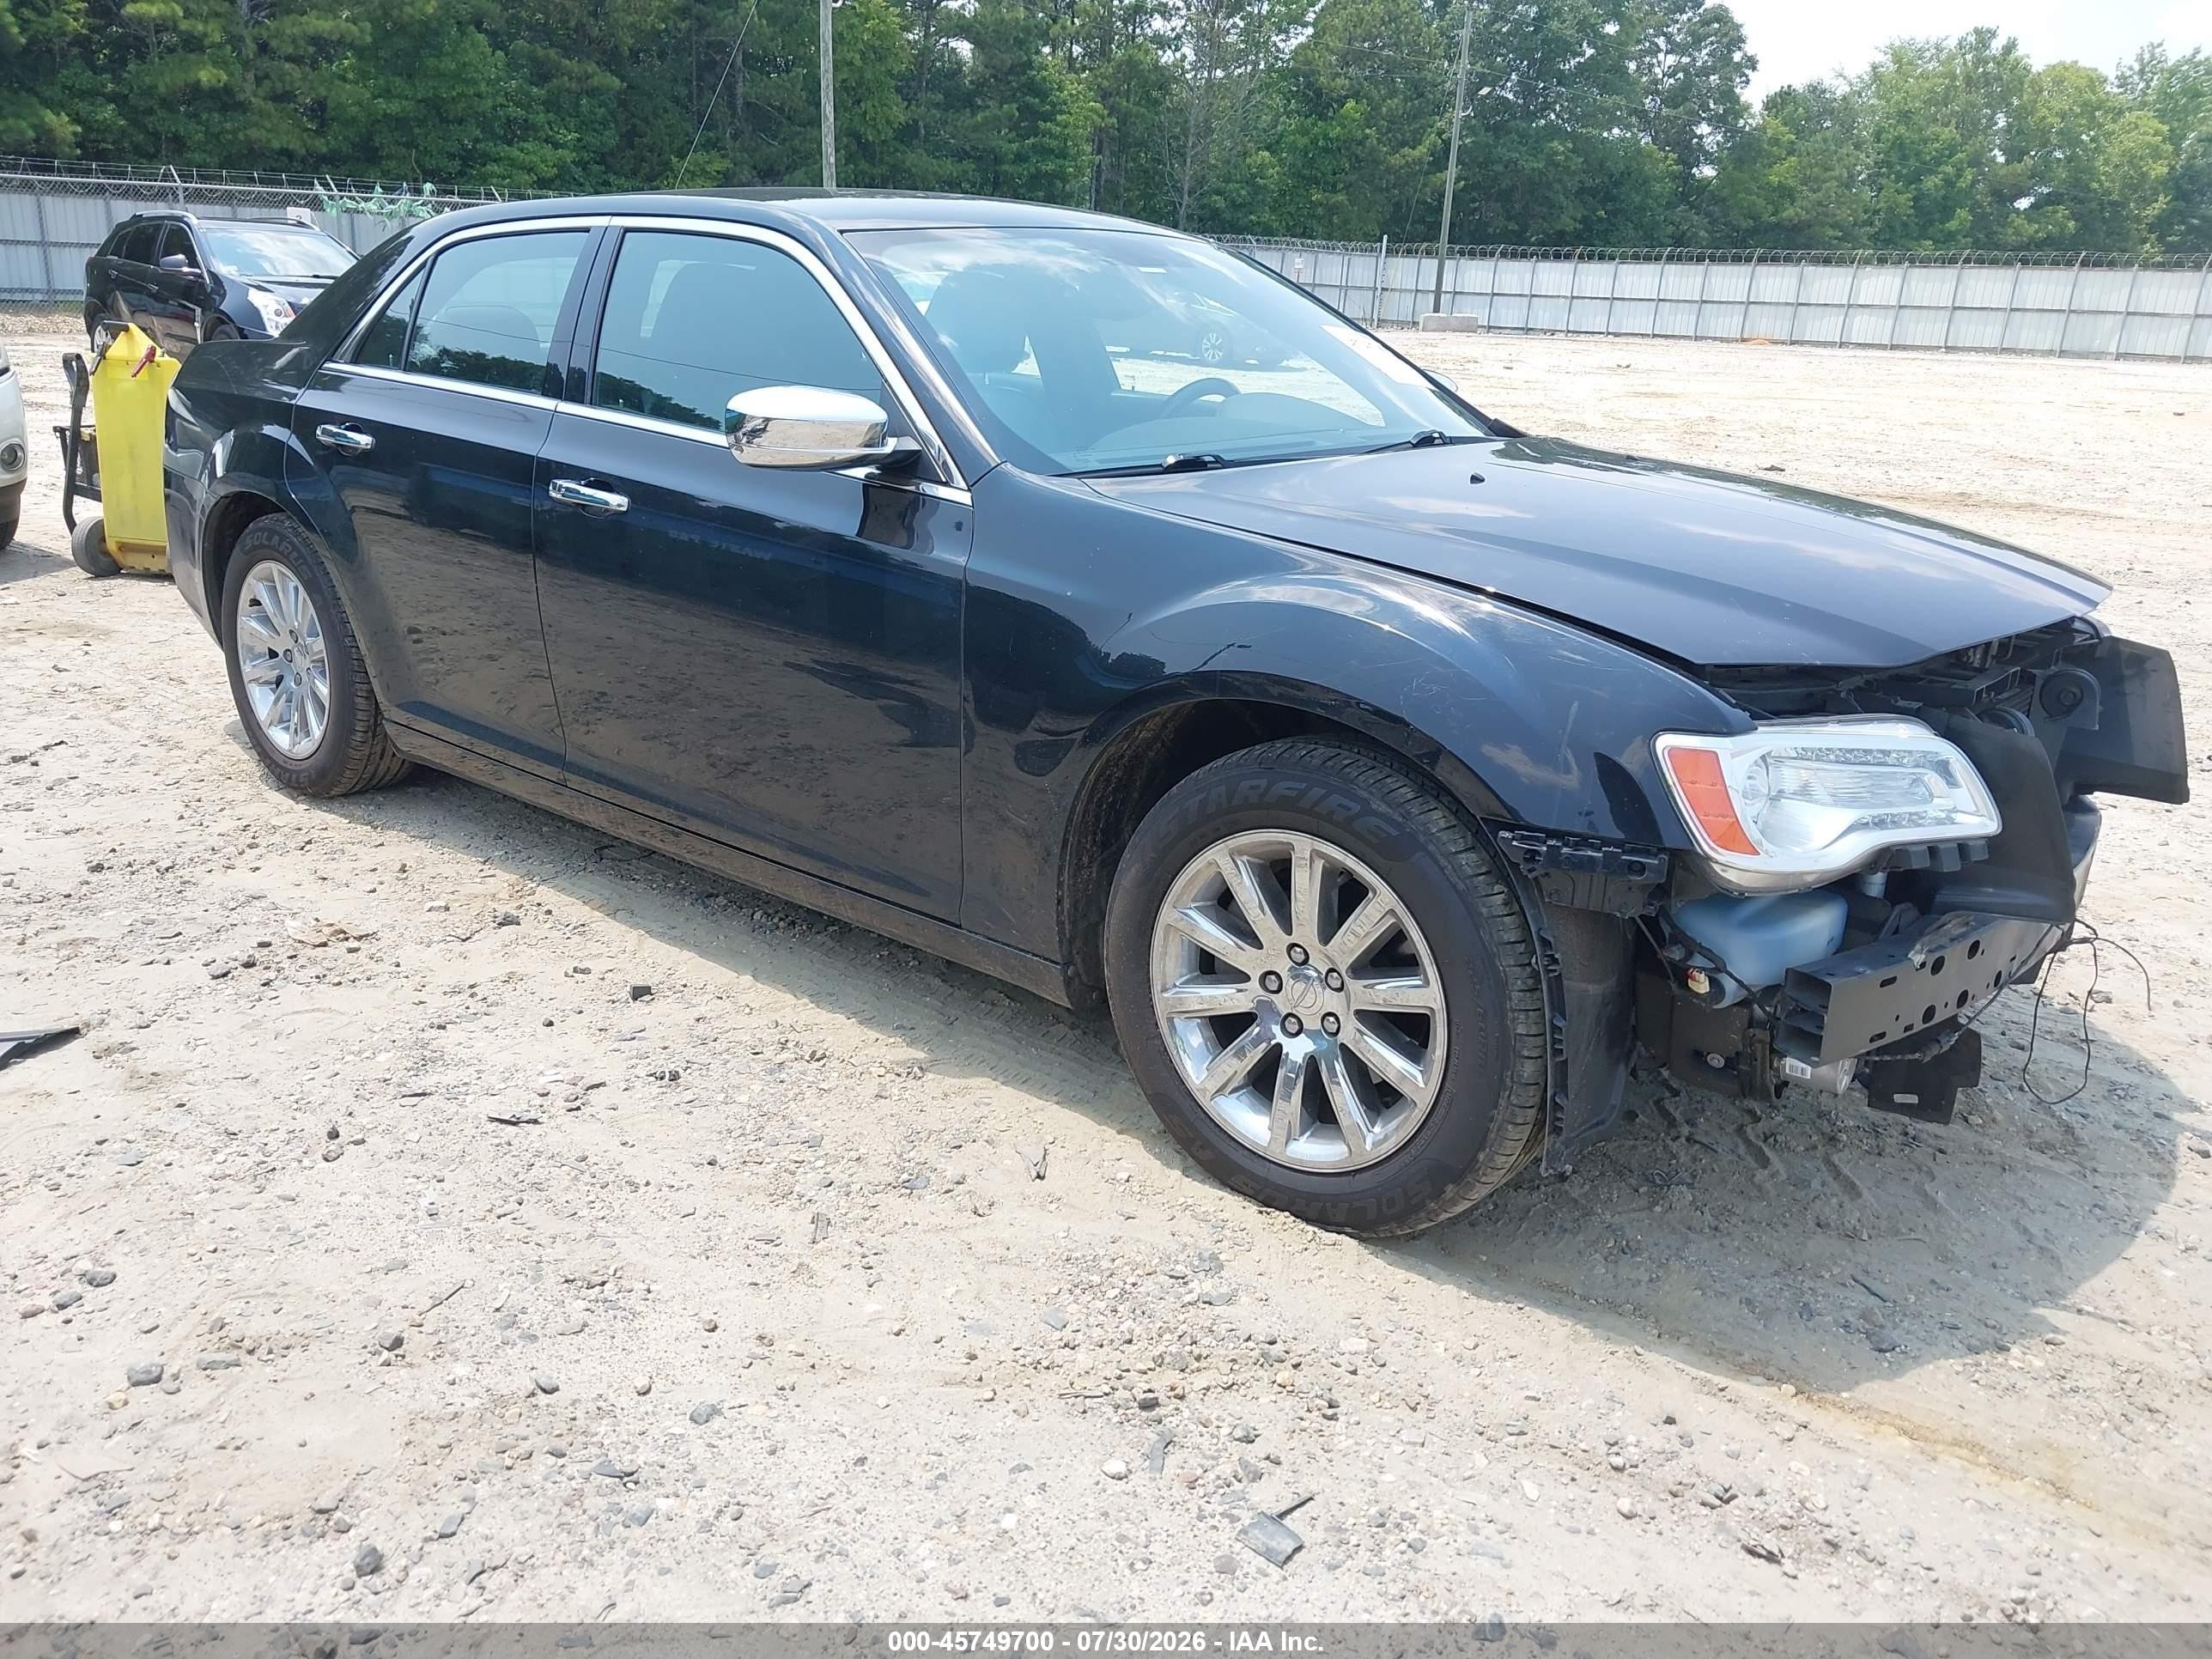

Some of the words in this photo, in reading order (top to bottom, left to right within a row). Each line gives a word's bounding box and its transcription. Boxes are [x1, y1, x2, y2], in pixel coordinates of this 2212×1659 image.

[242, 531, 313, 580] SOLARUS
[1158, 777, 1402, 845] STARFIRE
[1227, 1170, 1435, 1223] SOLARUS
